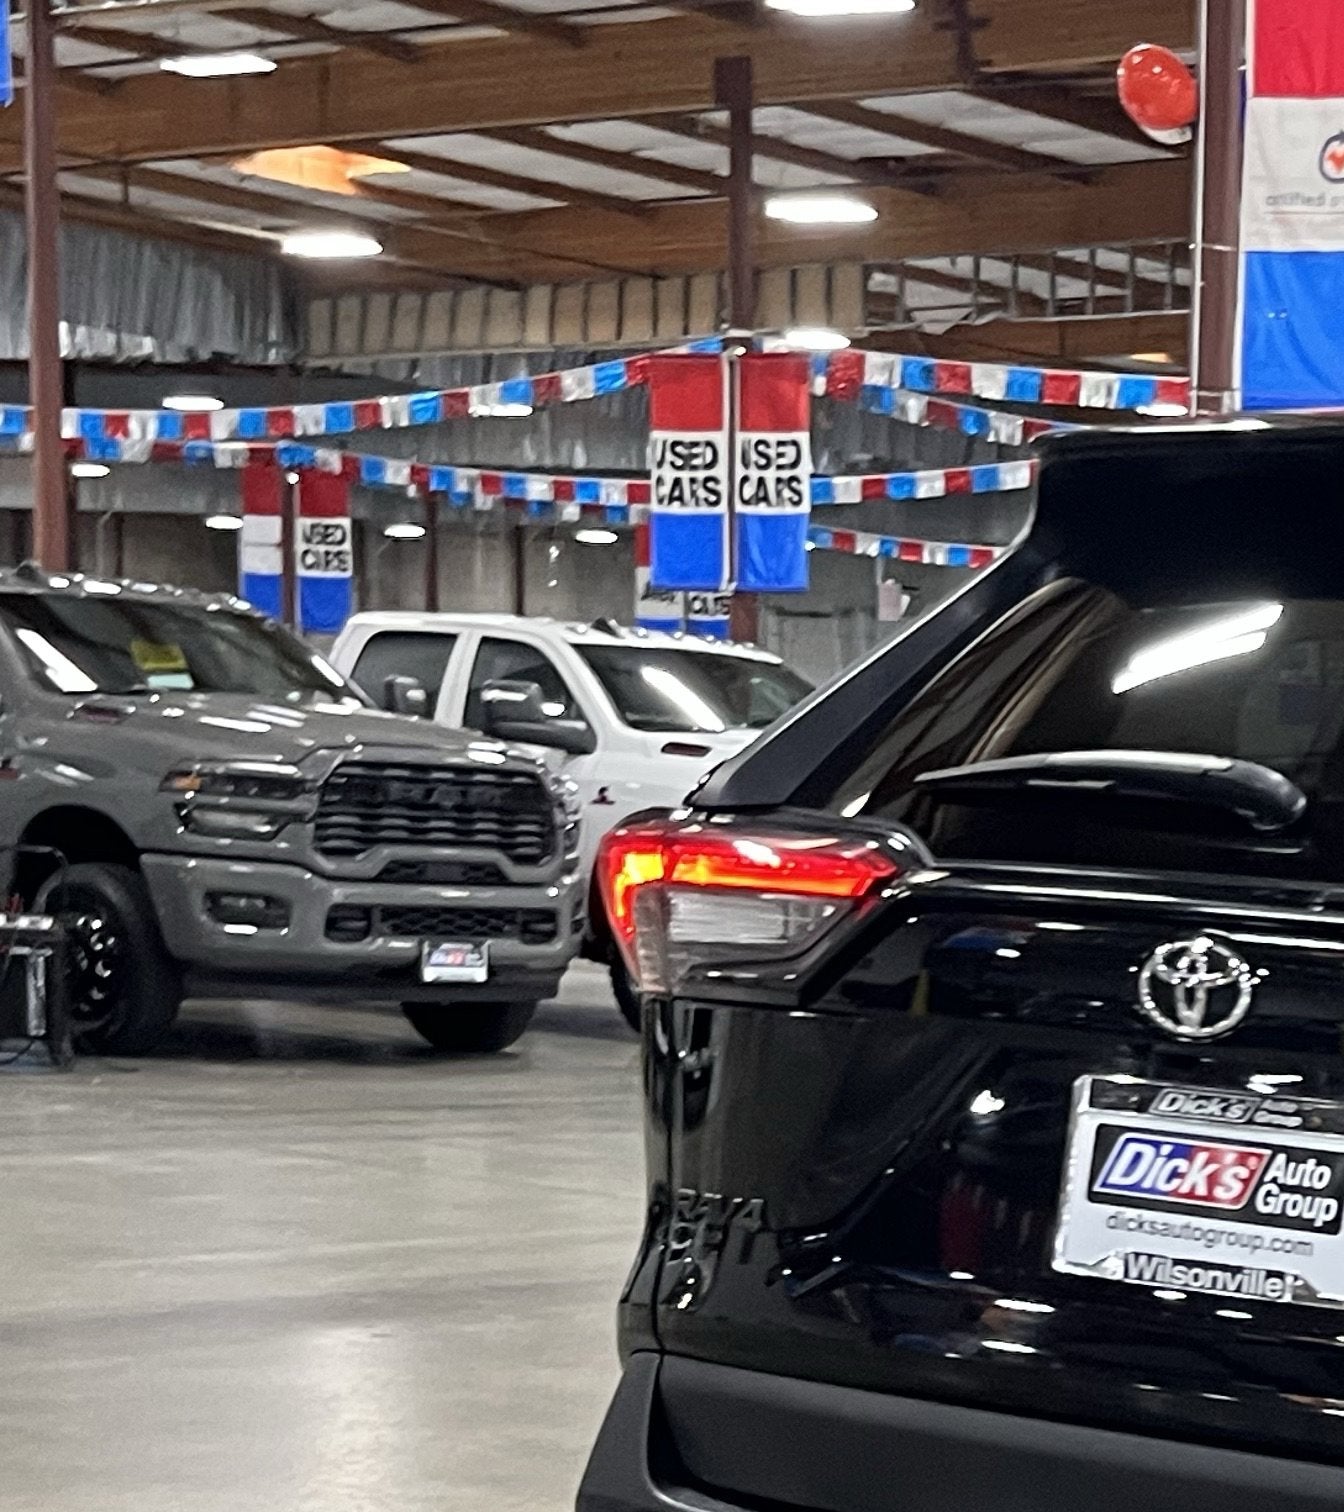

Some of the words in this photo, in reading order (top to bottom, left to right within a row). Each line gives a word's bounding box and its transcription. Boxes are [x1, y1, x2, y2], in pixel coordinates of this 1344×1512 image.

[741, 439, 802, 470] USED
[655, 475, 722, 506] CARS
[739, 475, 803, 506] CARS
[1108, 1142, 1249, 1202] Dick's
[1264, 1153, 1332, 1190] Auto
[1254, 1182, 1339, 1228] Group
[1106, 1210, 1316, 1257] dicksautogroup.com
[1125, 1251, 1289, 1300] Wilsonville
